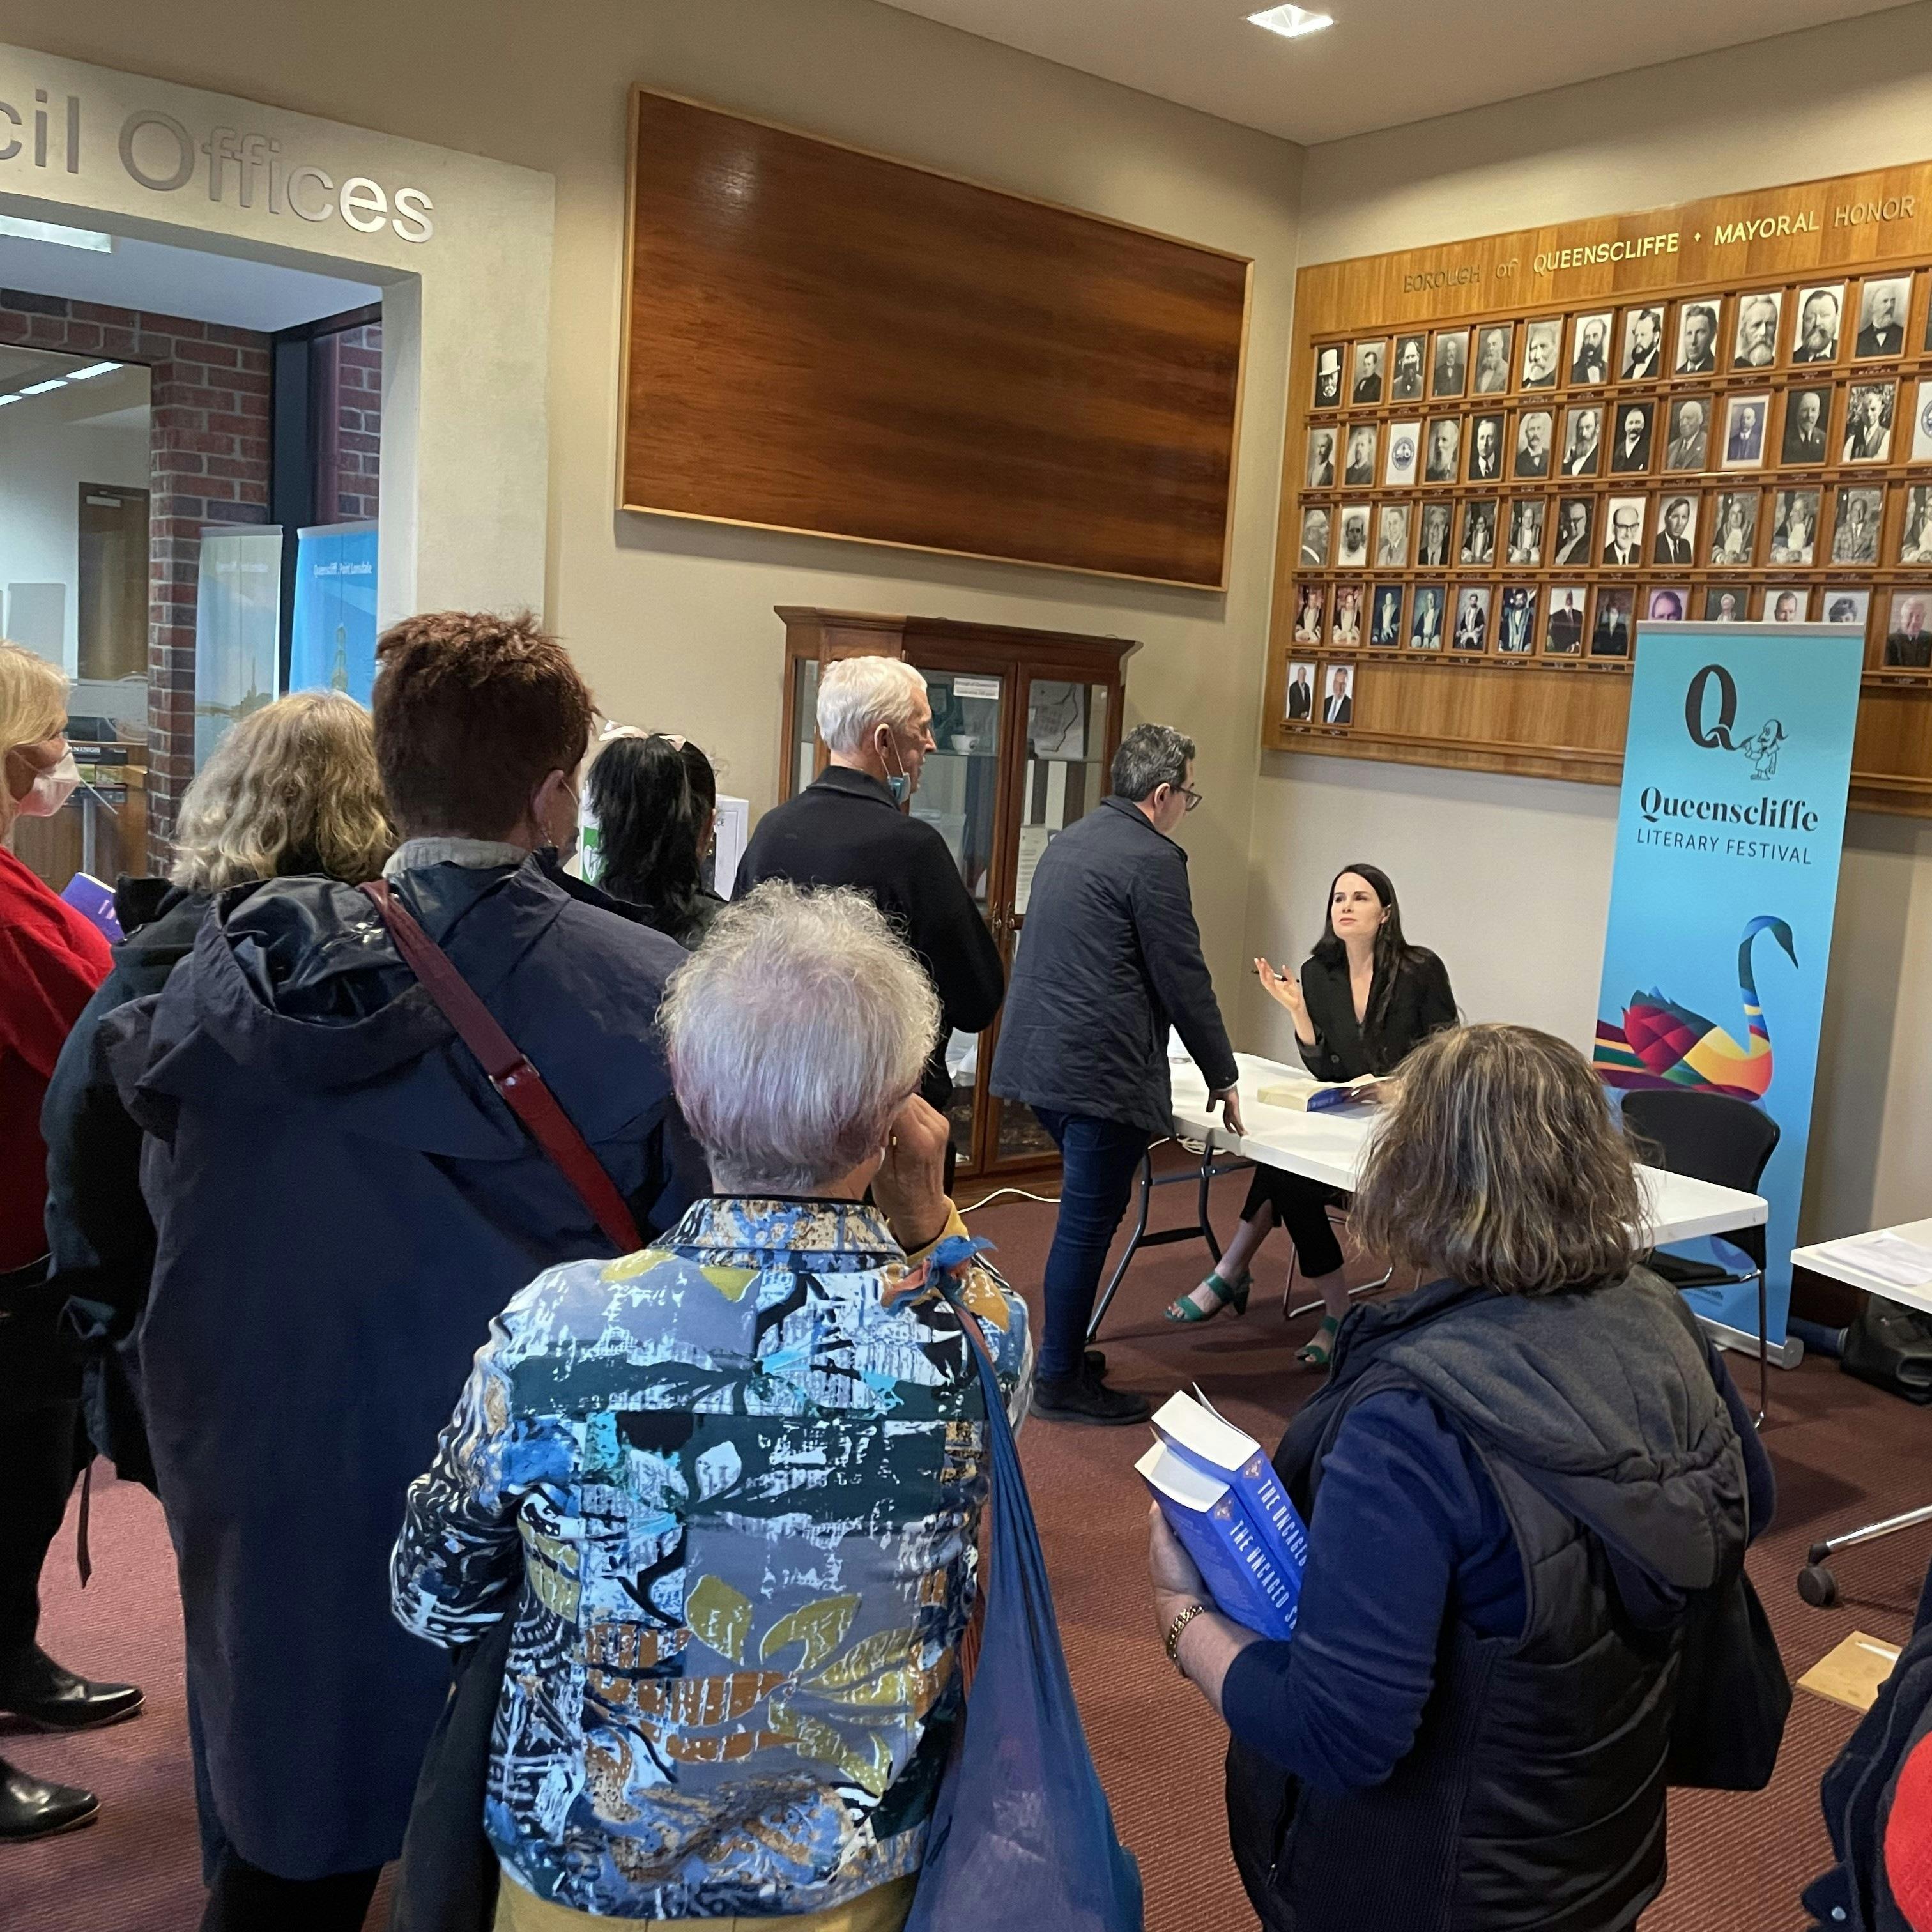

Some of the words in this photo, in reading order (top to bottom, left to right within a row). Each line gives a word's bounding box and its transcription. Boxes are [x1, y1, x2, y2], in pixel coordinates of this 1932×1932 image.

[119, 109, 434, 243] Offices
[1404, 264, 1482, 293] BOROUGH
[1534, 233, 1680, 277] QUEENSCLIFFE
[1714, 211, 1820, 246] MAYORAL
[1834, 195, 1915, 229] HONOR
[1641, 786, 1818, 832] Queenscliffe
[1637, 828, 1719, 852] LITERARY
[1726, 839, 1812, 865] FESTIVAL
[1257, 1478, 1281, 1510] THE
[1230, 1519, 1254, 1552] THE
[1246, 1546, 1289, 1609] UNCAGED
